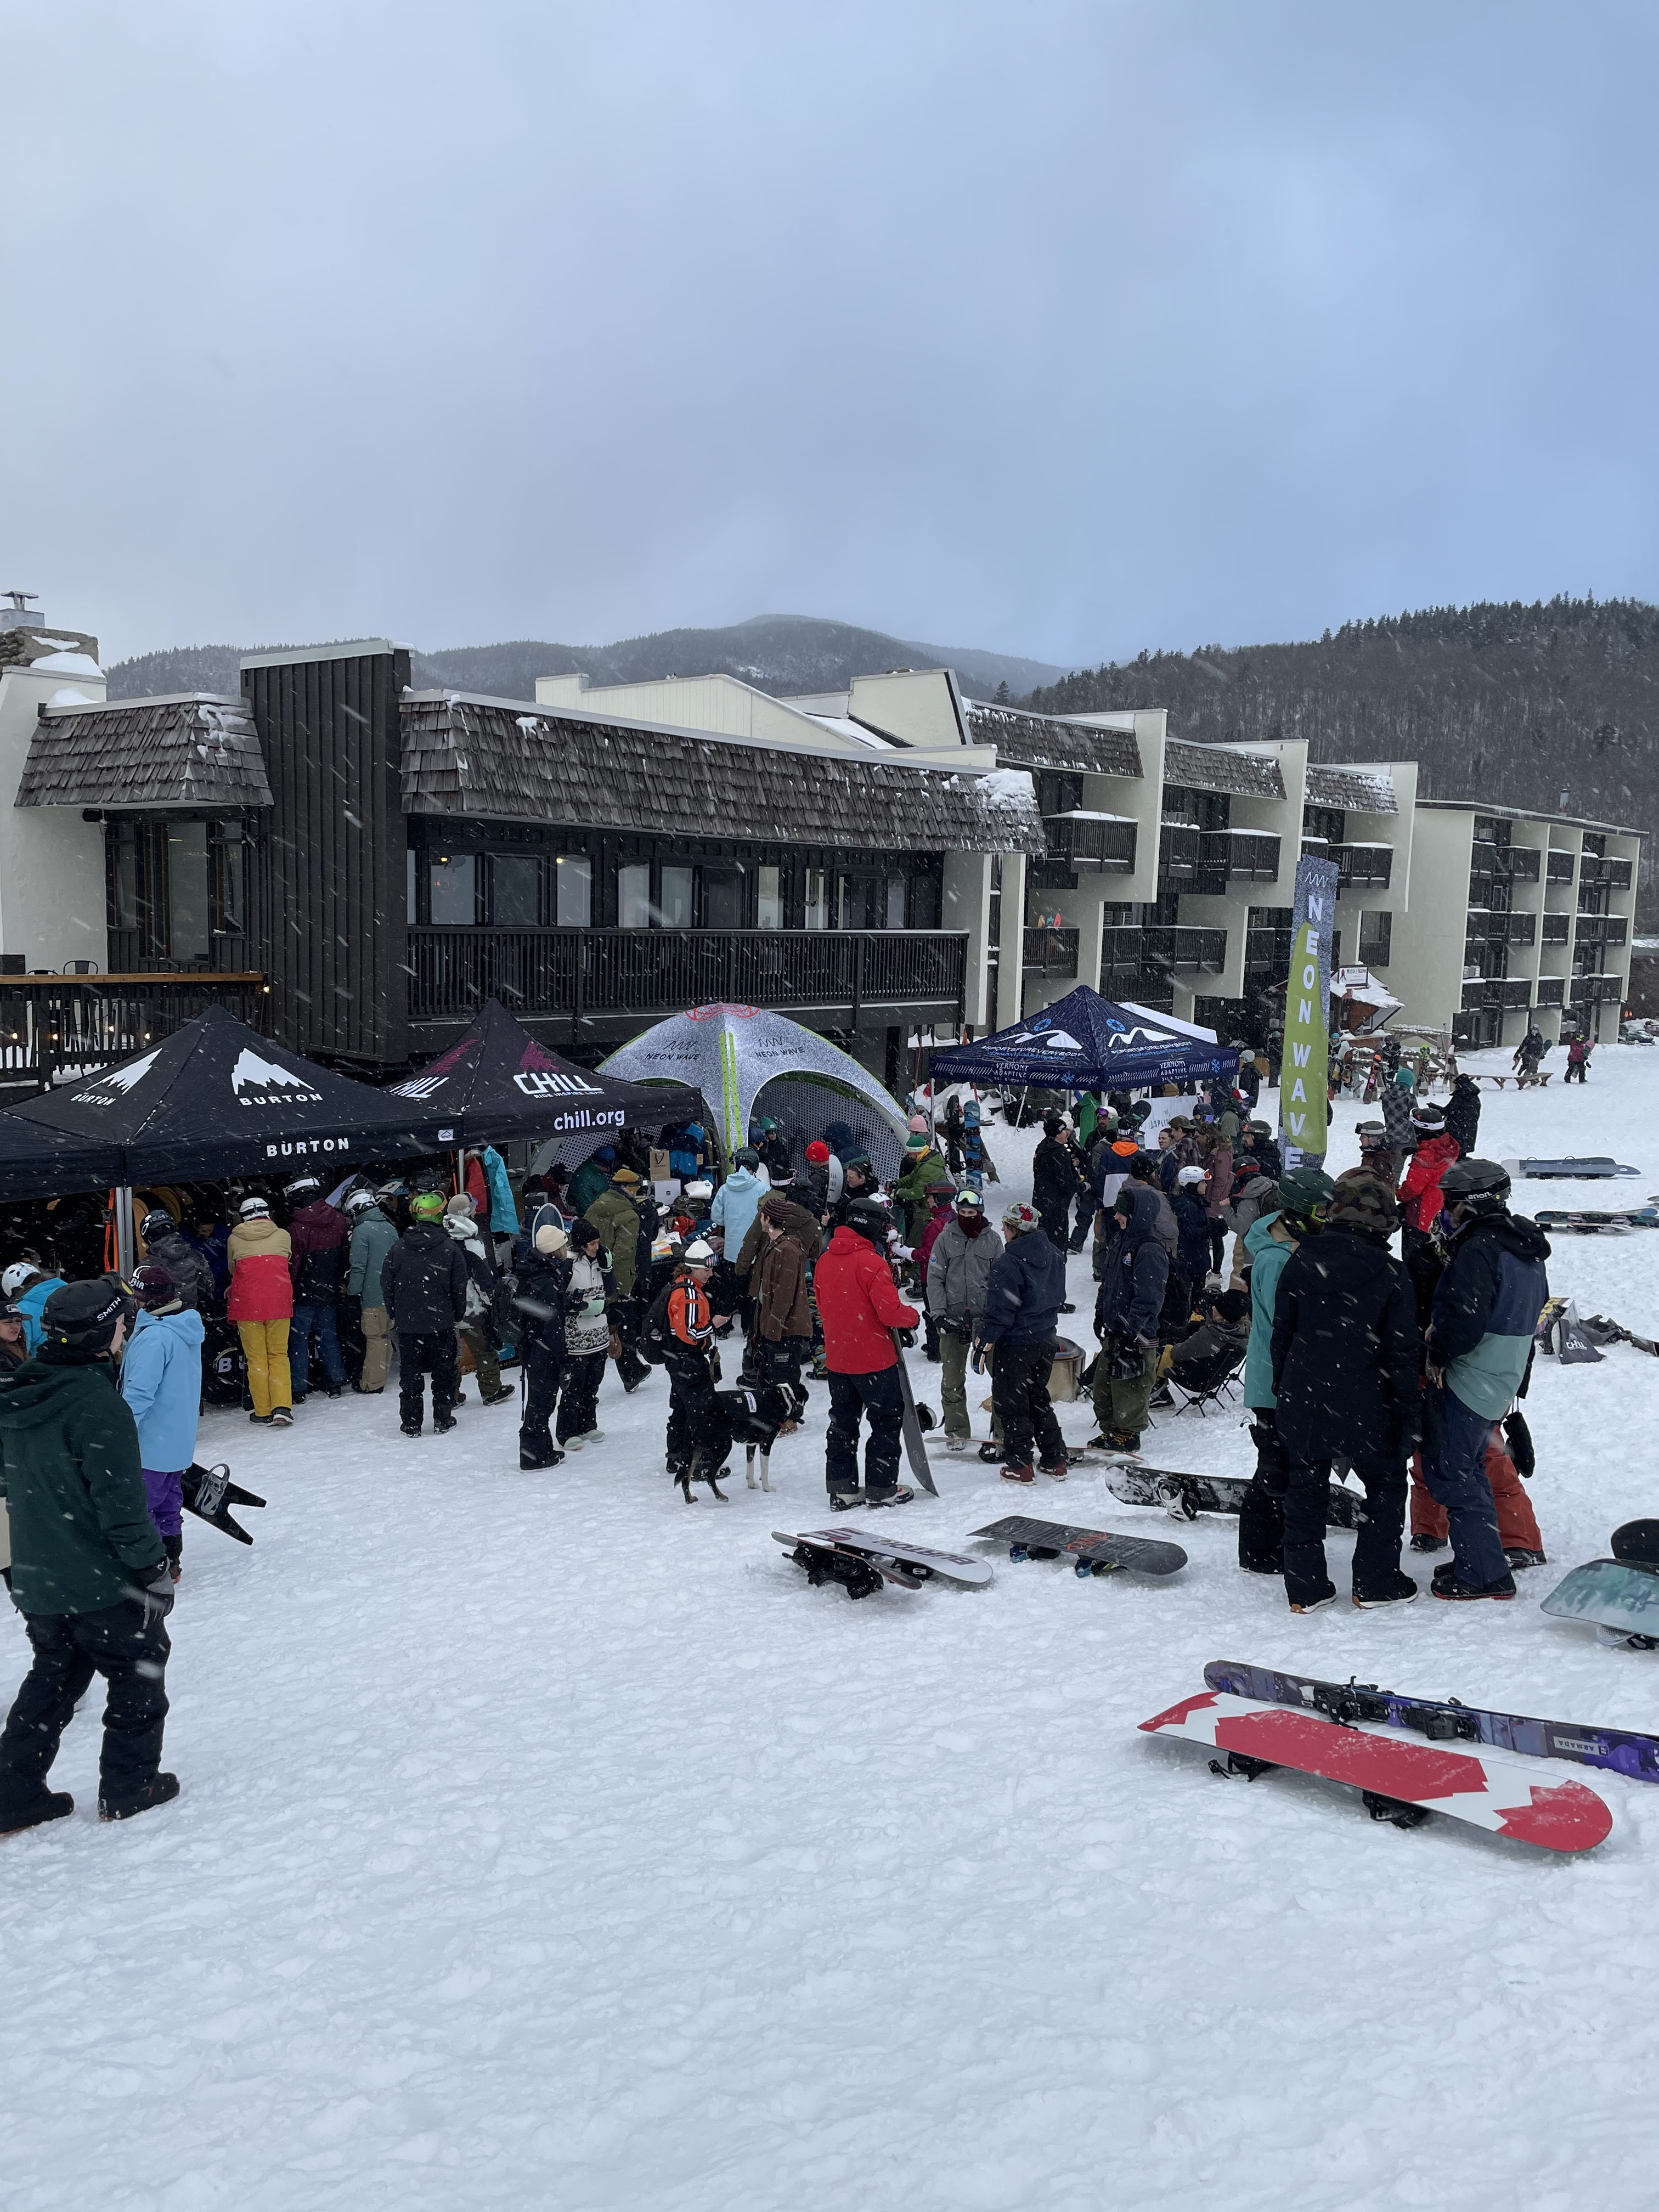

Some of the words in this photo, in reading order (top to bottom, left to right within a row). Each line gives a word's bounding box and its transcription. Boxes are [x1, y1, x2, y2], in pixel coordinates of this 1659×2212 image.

[1299, 895, 1323, 1024] NEON
[755, 1050, 777, 1058] NEON
[781, 1047, 805, 1056] WAVE
[981, 1045, 1088, 1058] #SPORTSFOREVERYBODY
[1111, 1041, 1192, 1054] #SPORTSFOREVERYBODY
[996, 1062, 1029, 1071] VERMONT
[1159, 1060, 1186, 1069] VERMONT
[995, 1070, 1027, 1078] ADAPTIVE
[1160, 1068, 1187, 1076] ADAPTIVE
[513, 1073, 603, 1094] CHILL
[70, 1094, 116, 1106] BURTON
[239, 1093, 323, 1105] BURTON
[1285, 1042, 1311, 1171] WAVE
[554, 1110, 624, 1130] chill.org
[267, 1138, 349, 1157] BURTON
[97, 1297, 121, 1321] SMITH
[1558, 1739, 1594, 1752] ARMADA
